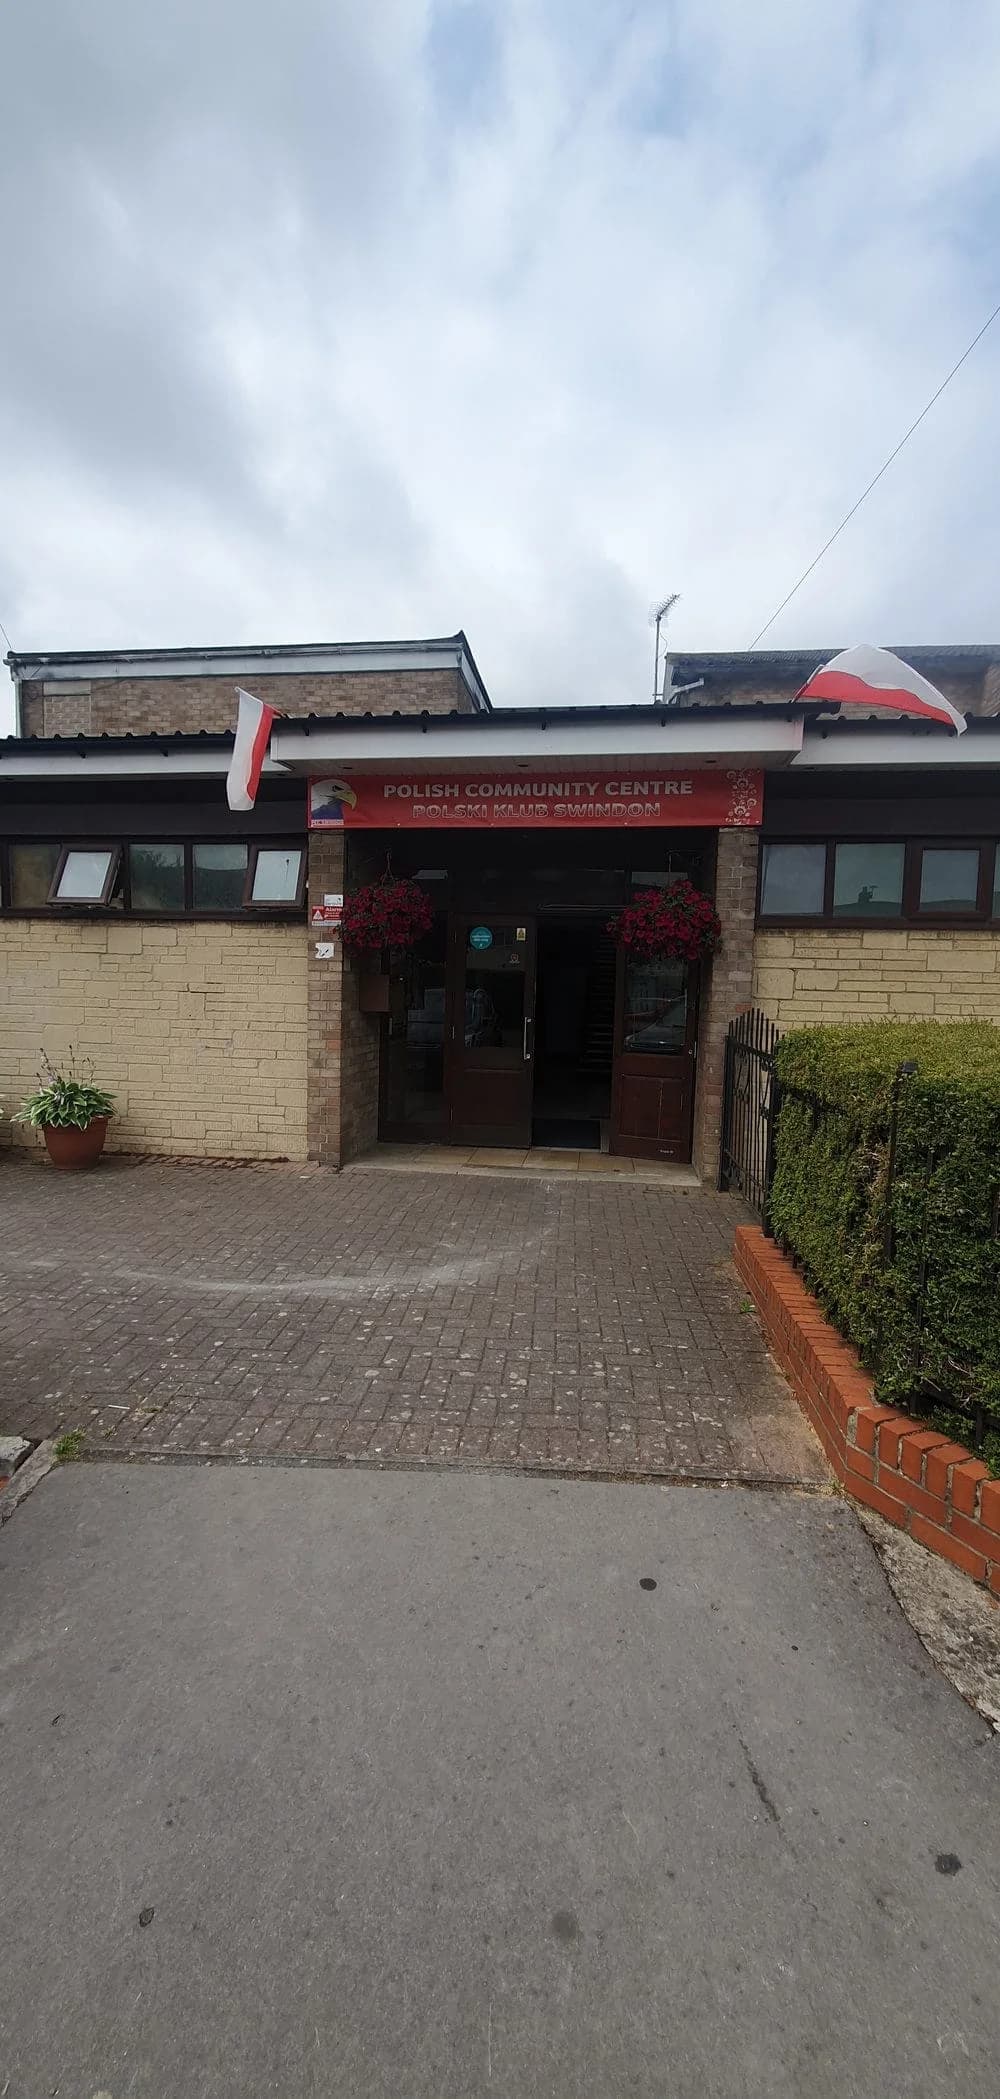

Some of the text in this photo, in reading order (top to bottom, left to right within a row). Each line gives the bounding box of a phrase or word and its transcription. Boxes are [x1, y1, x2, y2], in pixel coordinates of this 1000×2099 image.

[383, 780, 694, 798] POLISH COMMUNITY CENTRE
[412, 802, 662, 819] POLSKI KLUB SWINDON
